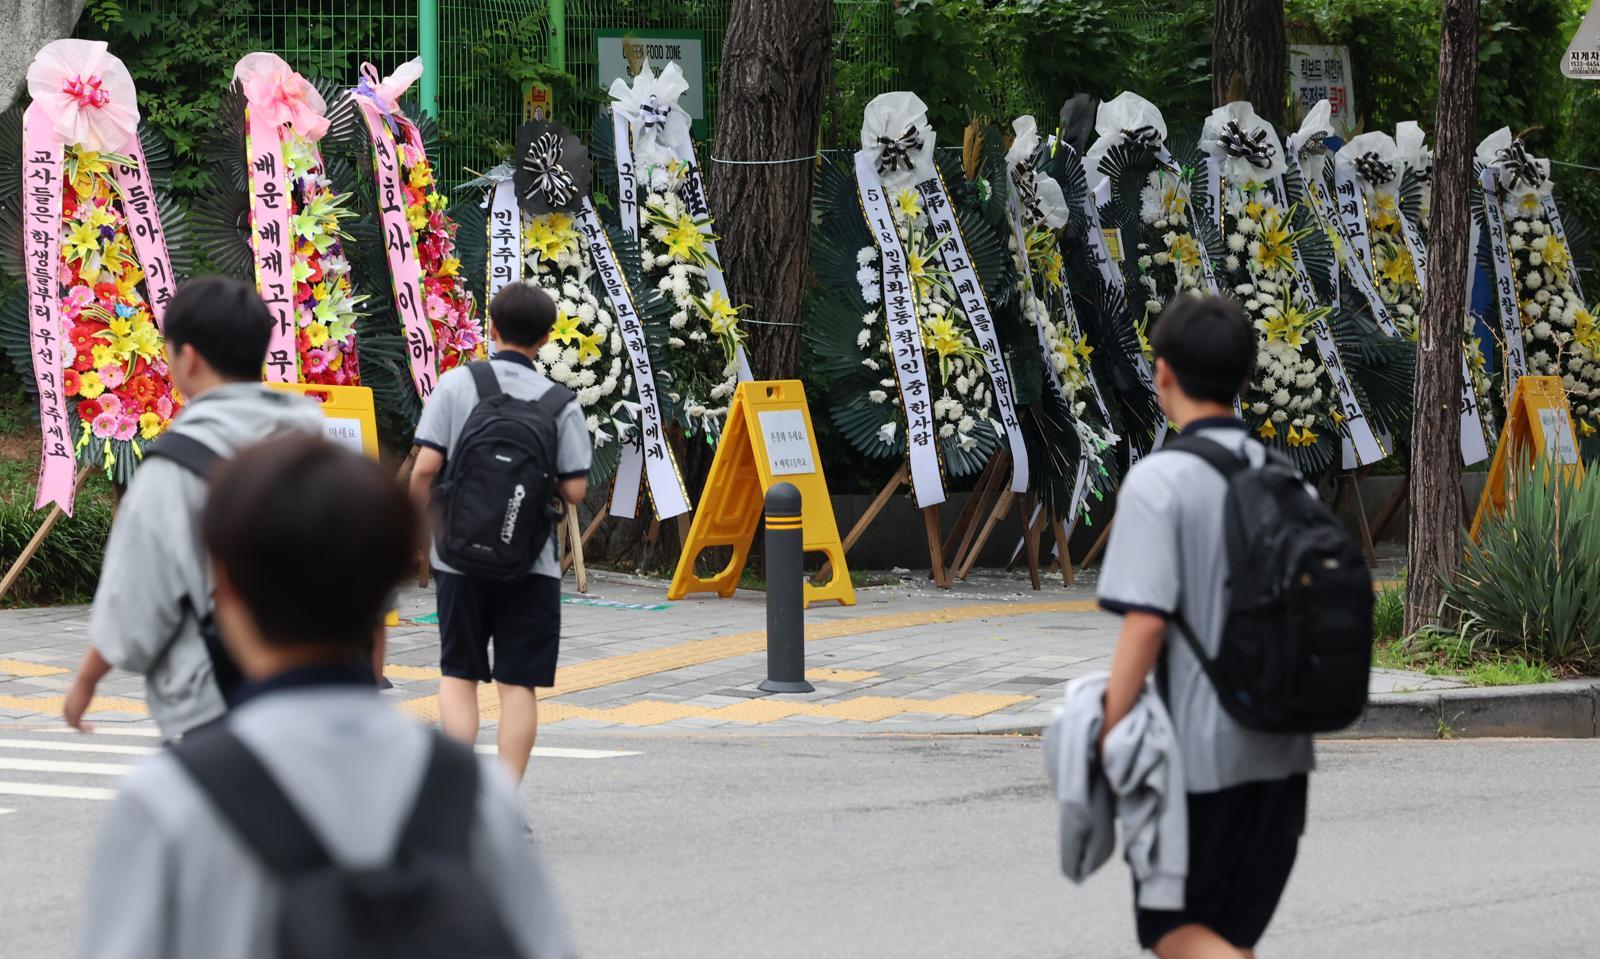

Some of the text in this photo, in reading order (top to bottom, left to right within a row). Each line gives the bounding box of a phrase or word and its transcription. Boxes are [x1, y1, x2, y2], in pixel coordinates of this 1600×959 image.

[622, 45, 681, 60] GEEN FOOD ZONE
[1301, 58, 1344, 80] 킥보드 자전거
[1329, 85, 1348, 113] 금지
[29, 150, 57, 224] 교사들은
[254, 151, 283, 209] 배운
[1337, 179, 1364, 237] 배재고
[934, 219, 970, 273] 배재고
[35, 328, 55, 365] 우선
[267, 349, 293, 383] 무
[1324, 350, 1363, 422] 배재고
[641, 384, 664, 461] 국민에게
